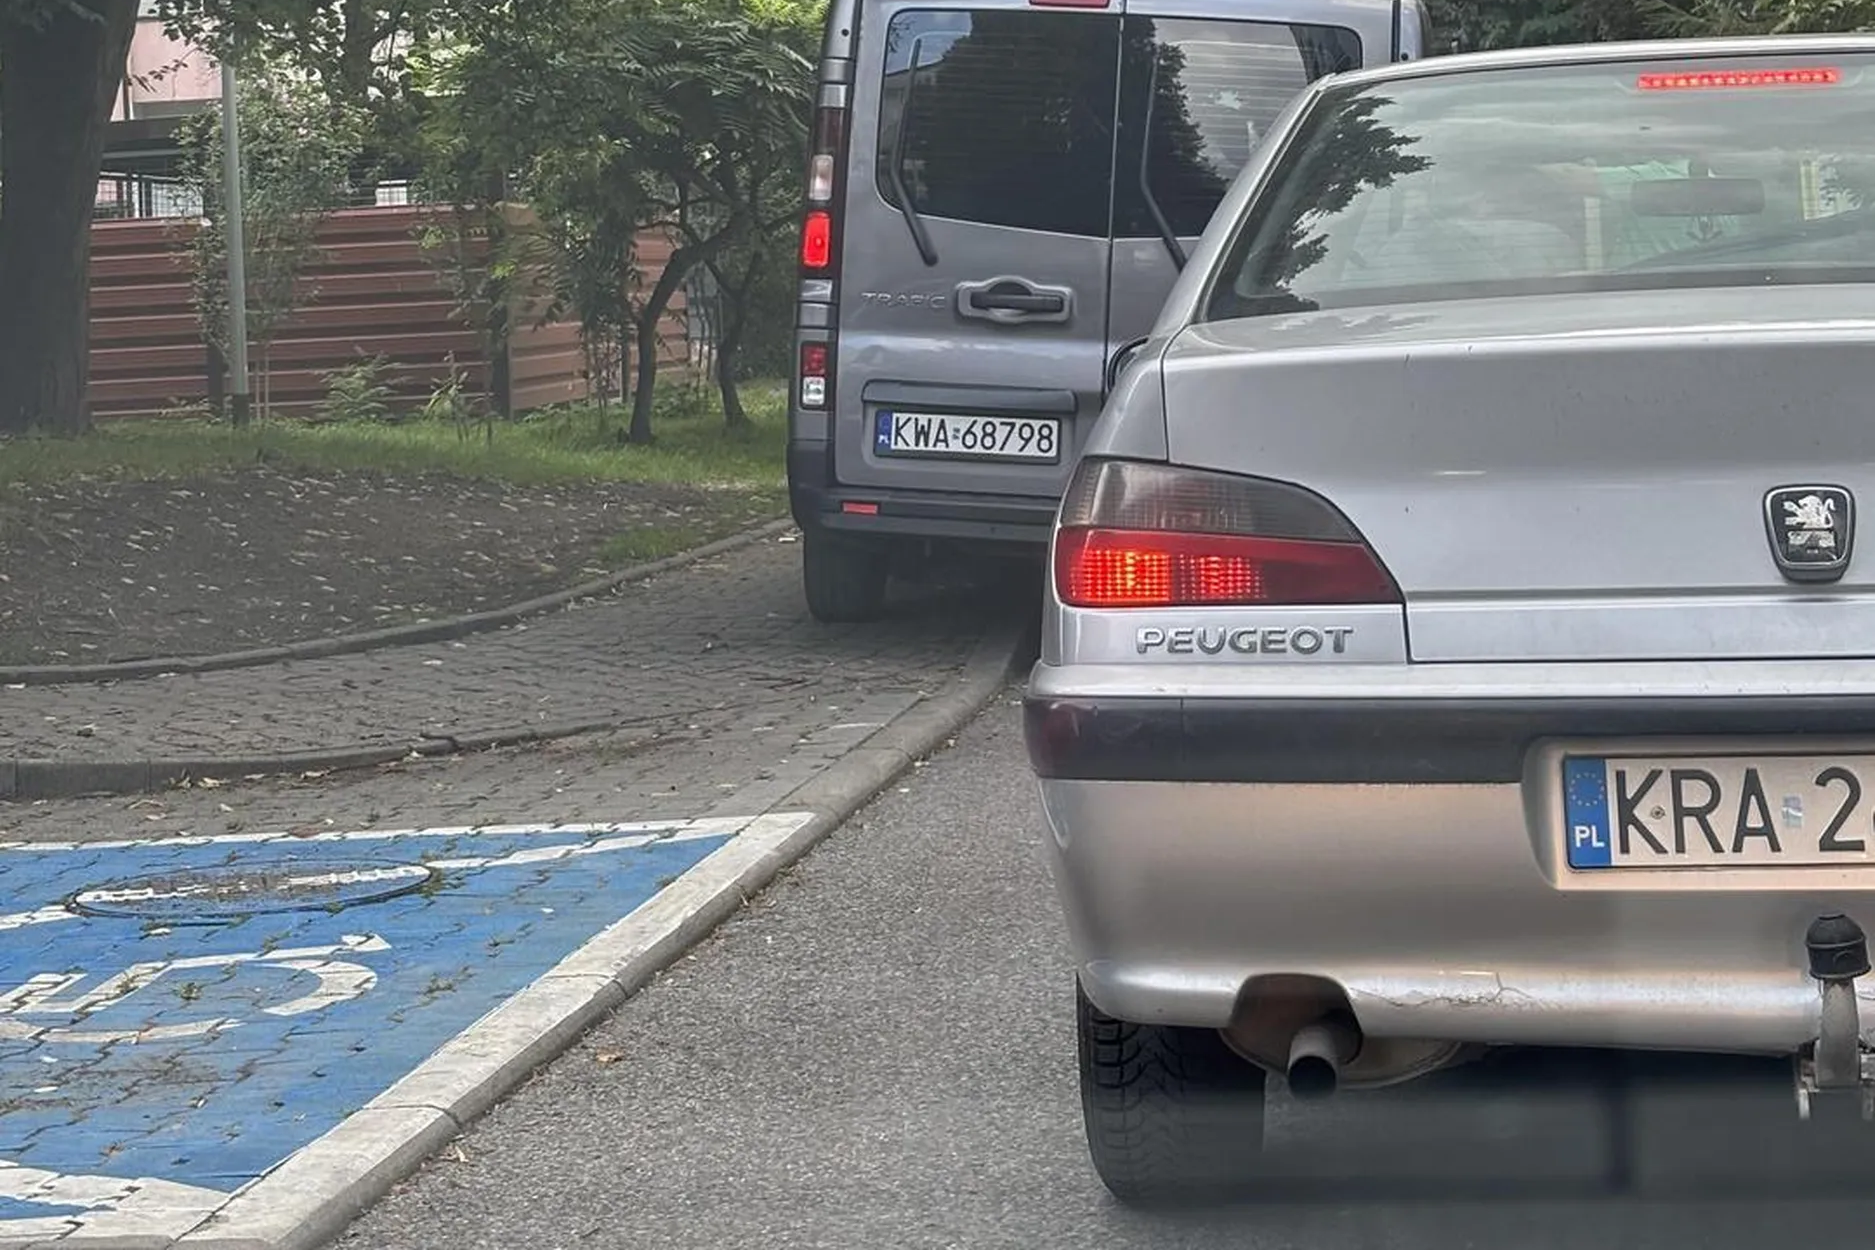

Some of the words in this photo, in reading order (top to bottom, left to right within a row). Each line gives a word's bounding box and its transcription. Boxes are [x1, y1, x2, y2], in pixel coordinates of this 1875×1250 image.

[893, 416, 949, 449] KWA
[961, 419, 1053, 454] 68798
[1136, 626, 1354, 655] PEUGEOT
[1615, 767, 1782, 854] KRA
[1814, 766, 1875, 853] 2
[1574, 825, 1605, 848] PL
